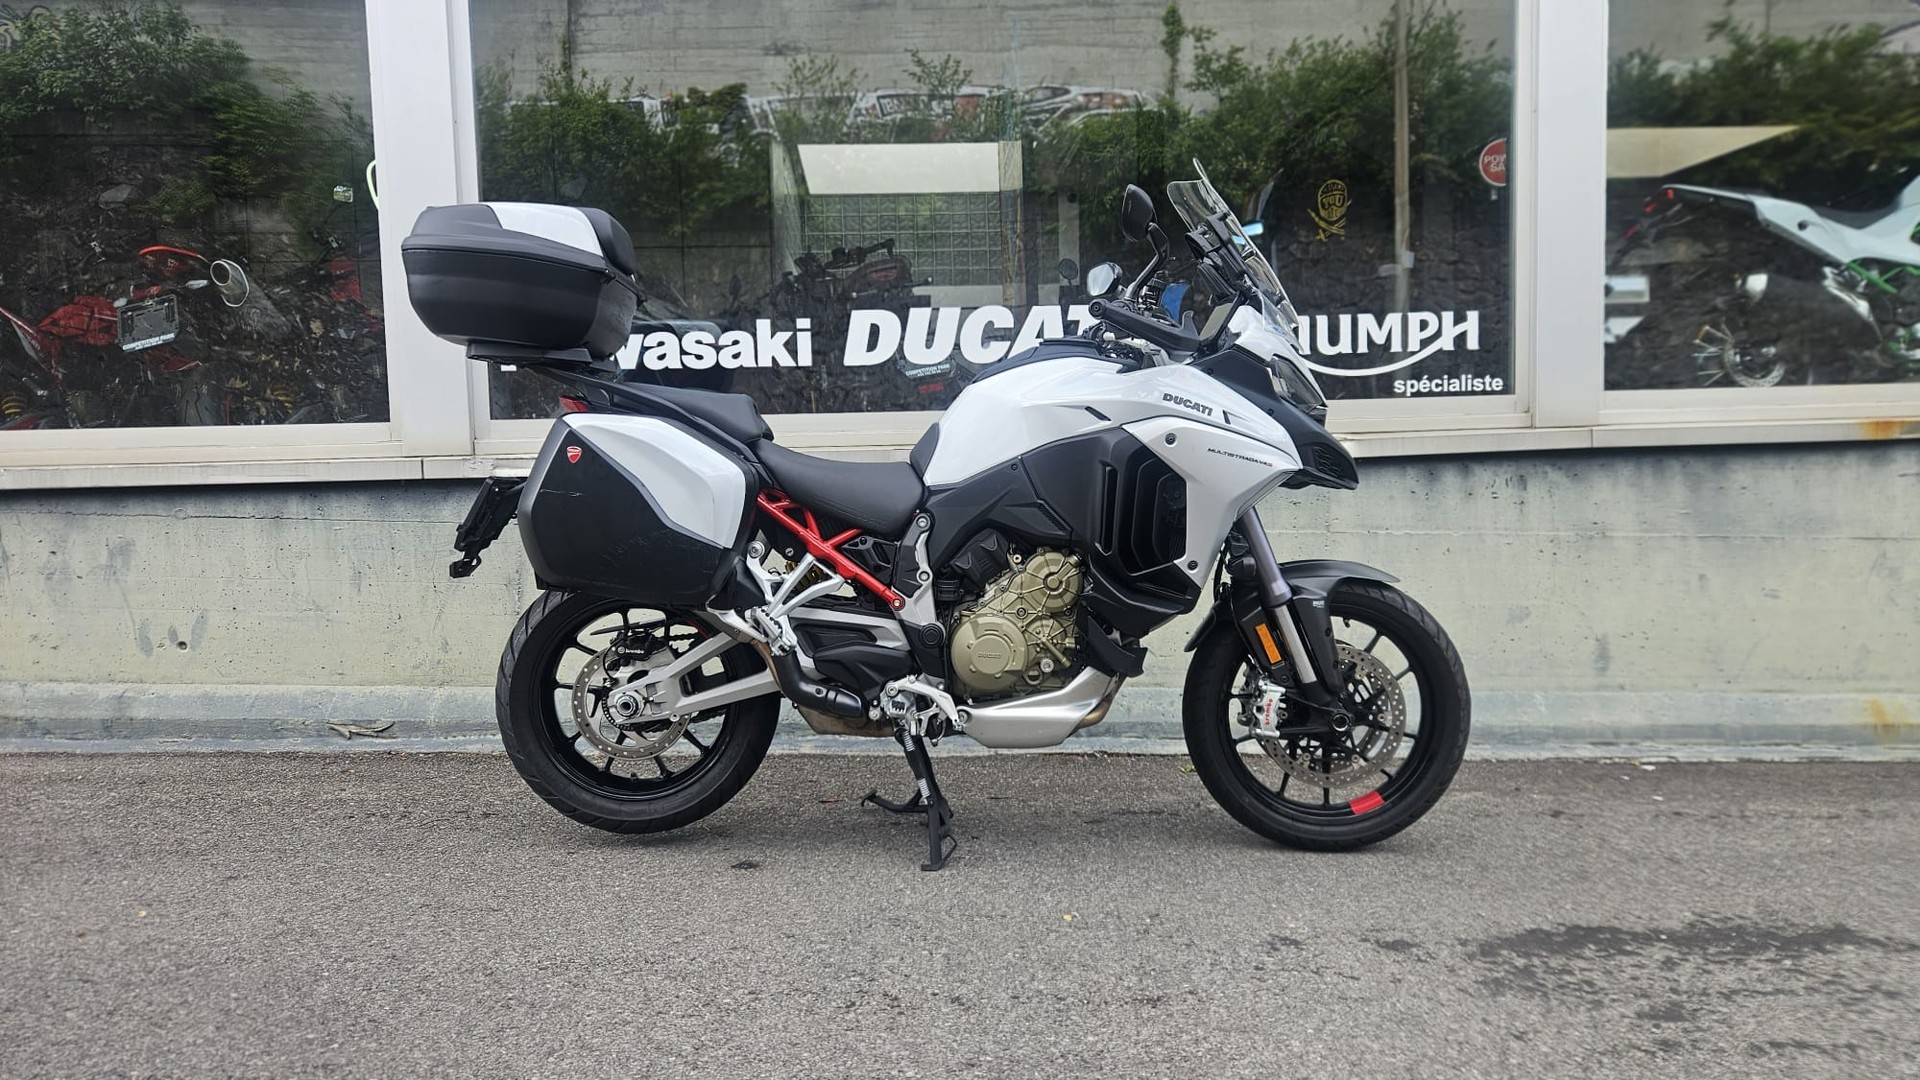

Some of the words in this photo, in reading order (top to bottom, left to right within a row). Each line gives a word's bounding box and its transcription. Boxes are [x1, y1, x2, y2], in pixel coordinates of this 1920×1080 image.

[500, 317, 813, 372] wasaki
[843, 305, 1102, 367] DUCA
[1298, 310, 1480, 356] IUMPH
[1162, 392, 1214, 417] DUCATI
[1393, 374, 1504, 396] spécialiste
